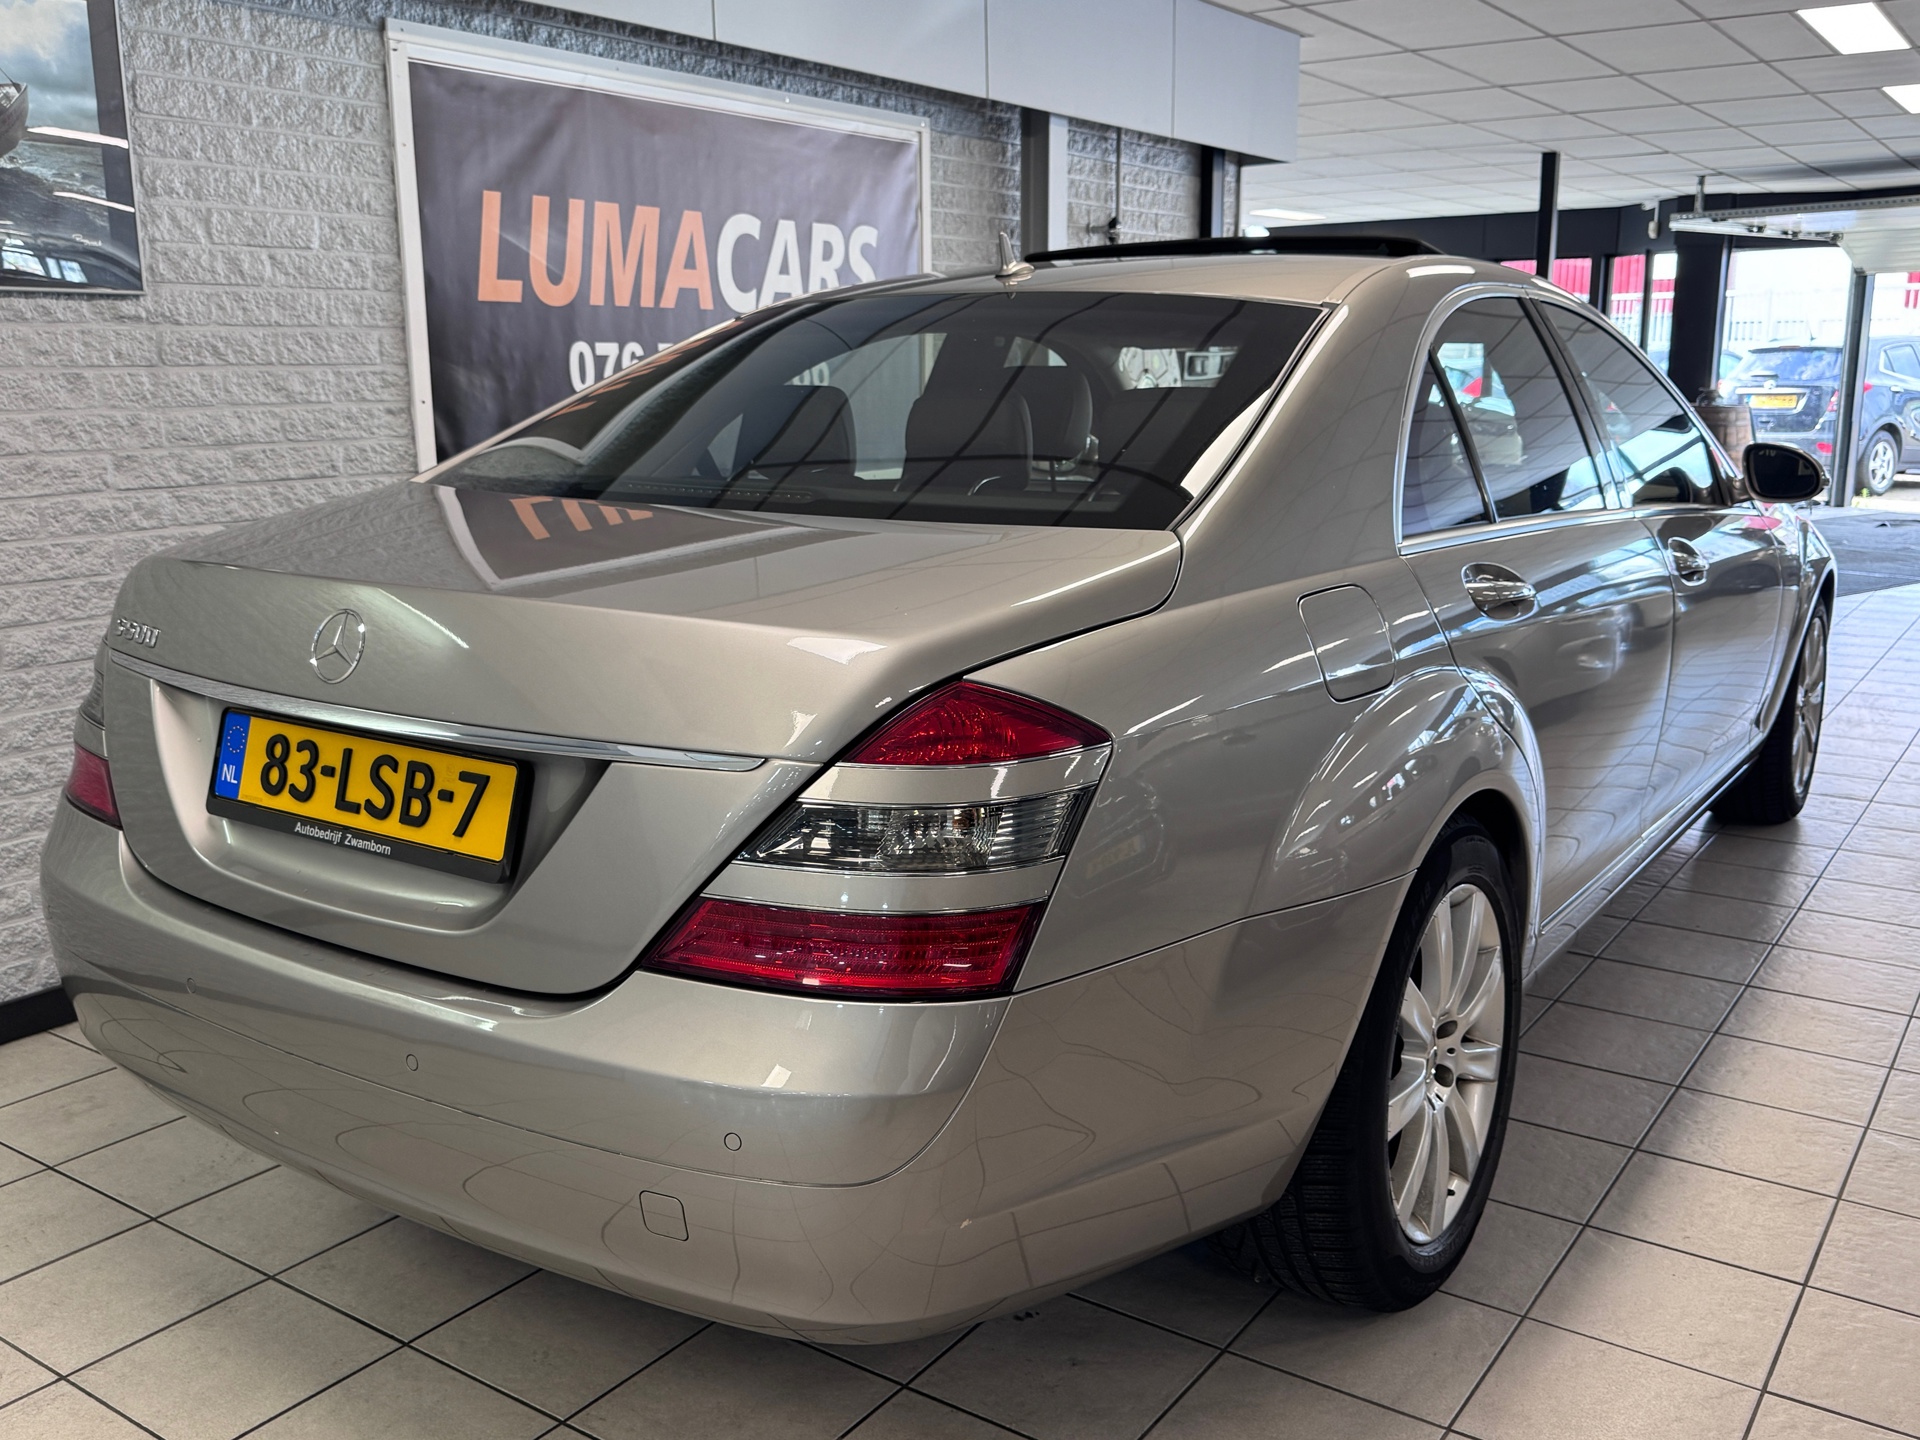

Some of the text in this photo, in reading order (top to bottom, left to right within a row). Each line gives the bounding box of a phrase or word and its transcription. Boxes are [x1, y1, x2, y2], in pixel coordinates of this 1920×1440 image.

[478, 190, 879, 316] LUMACARS
[221, 763, 238, 784] NL
[260, 733, 491, 838] 83-LSB-7
[294, 821, 392, 856] Autobedrijf Zwamborn
